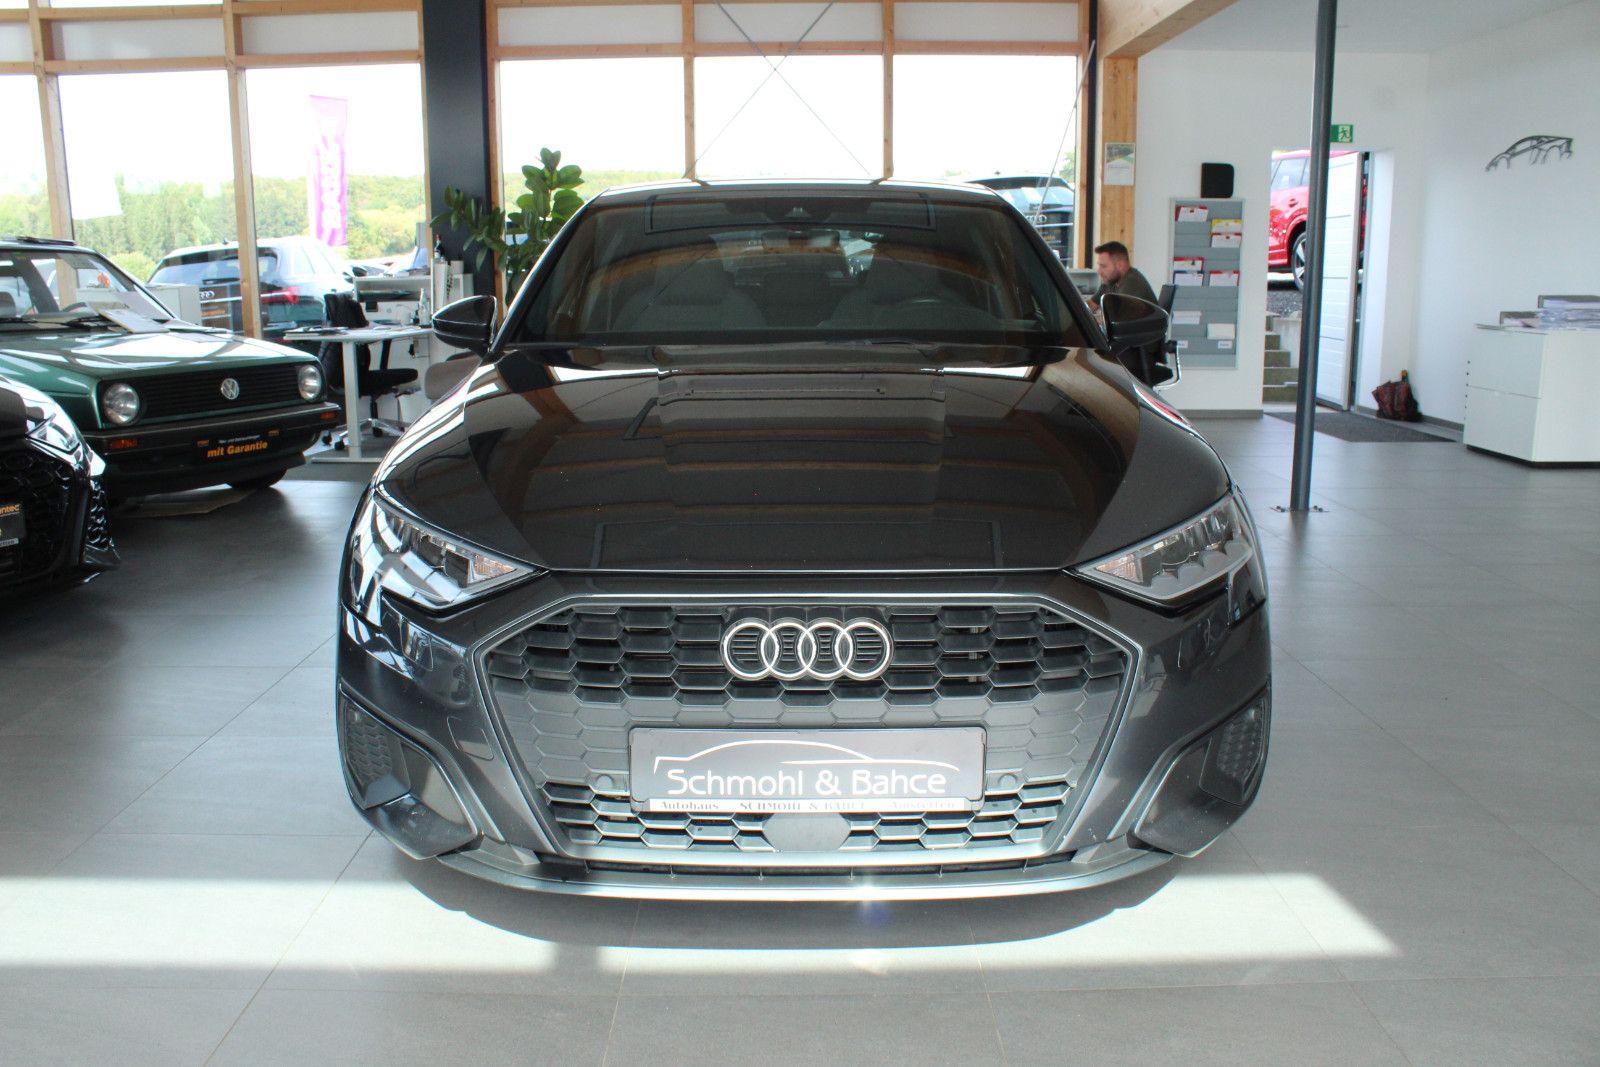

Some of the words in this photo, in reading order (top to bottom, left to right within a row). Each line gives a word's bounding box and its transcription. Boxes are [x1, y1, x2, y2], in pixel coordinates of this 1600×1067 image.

[207, 447, 224, 458] mit
[227, 441, 268, 455] Garantie
[667, 768, 802, 796] Schmohl
[815, 769, 842, 796] &
[852, 768, 947, 796] Bahce
[661, 801, 719, 811] Autohaus
